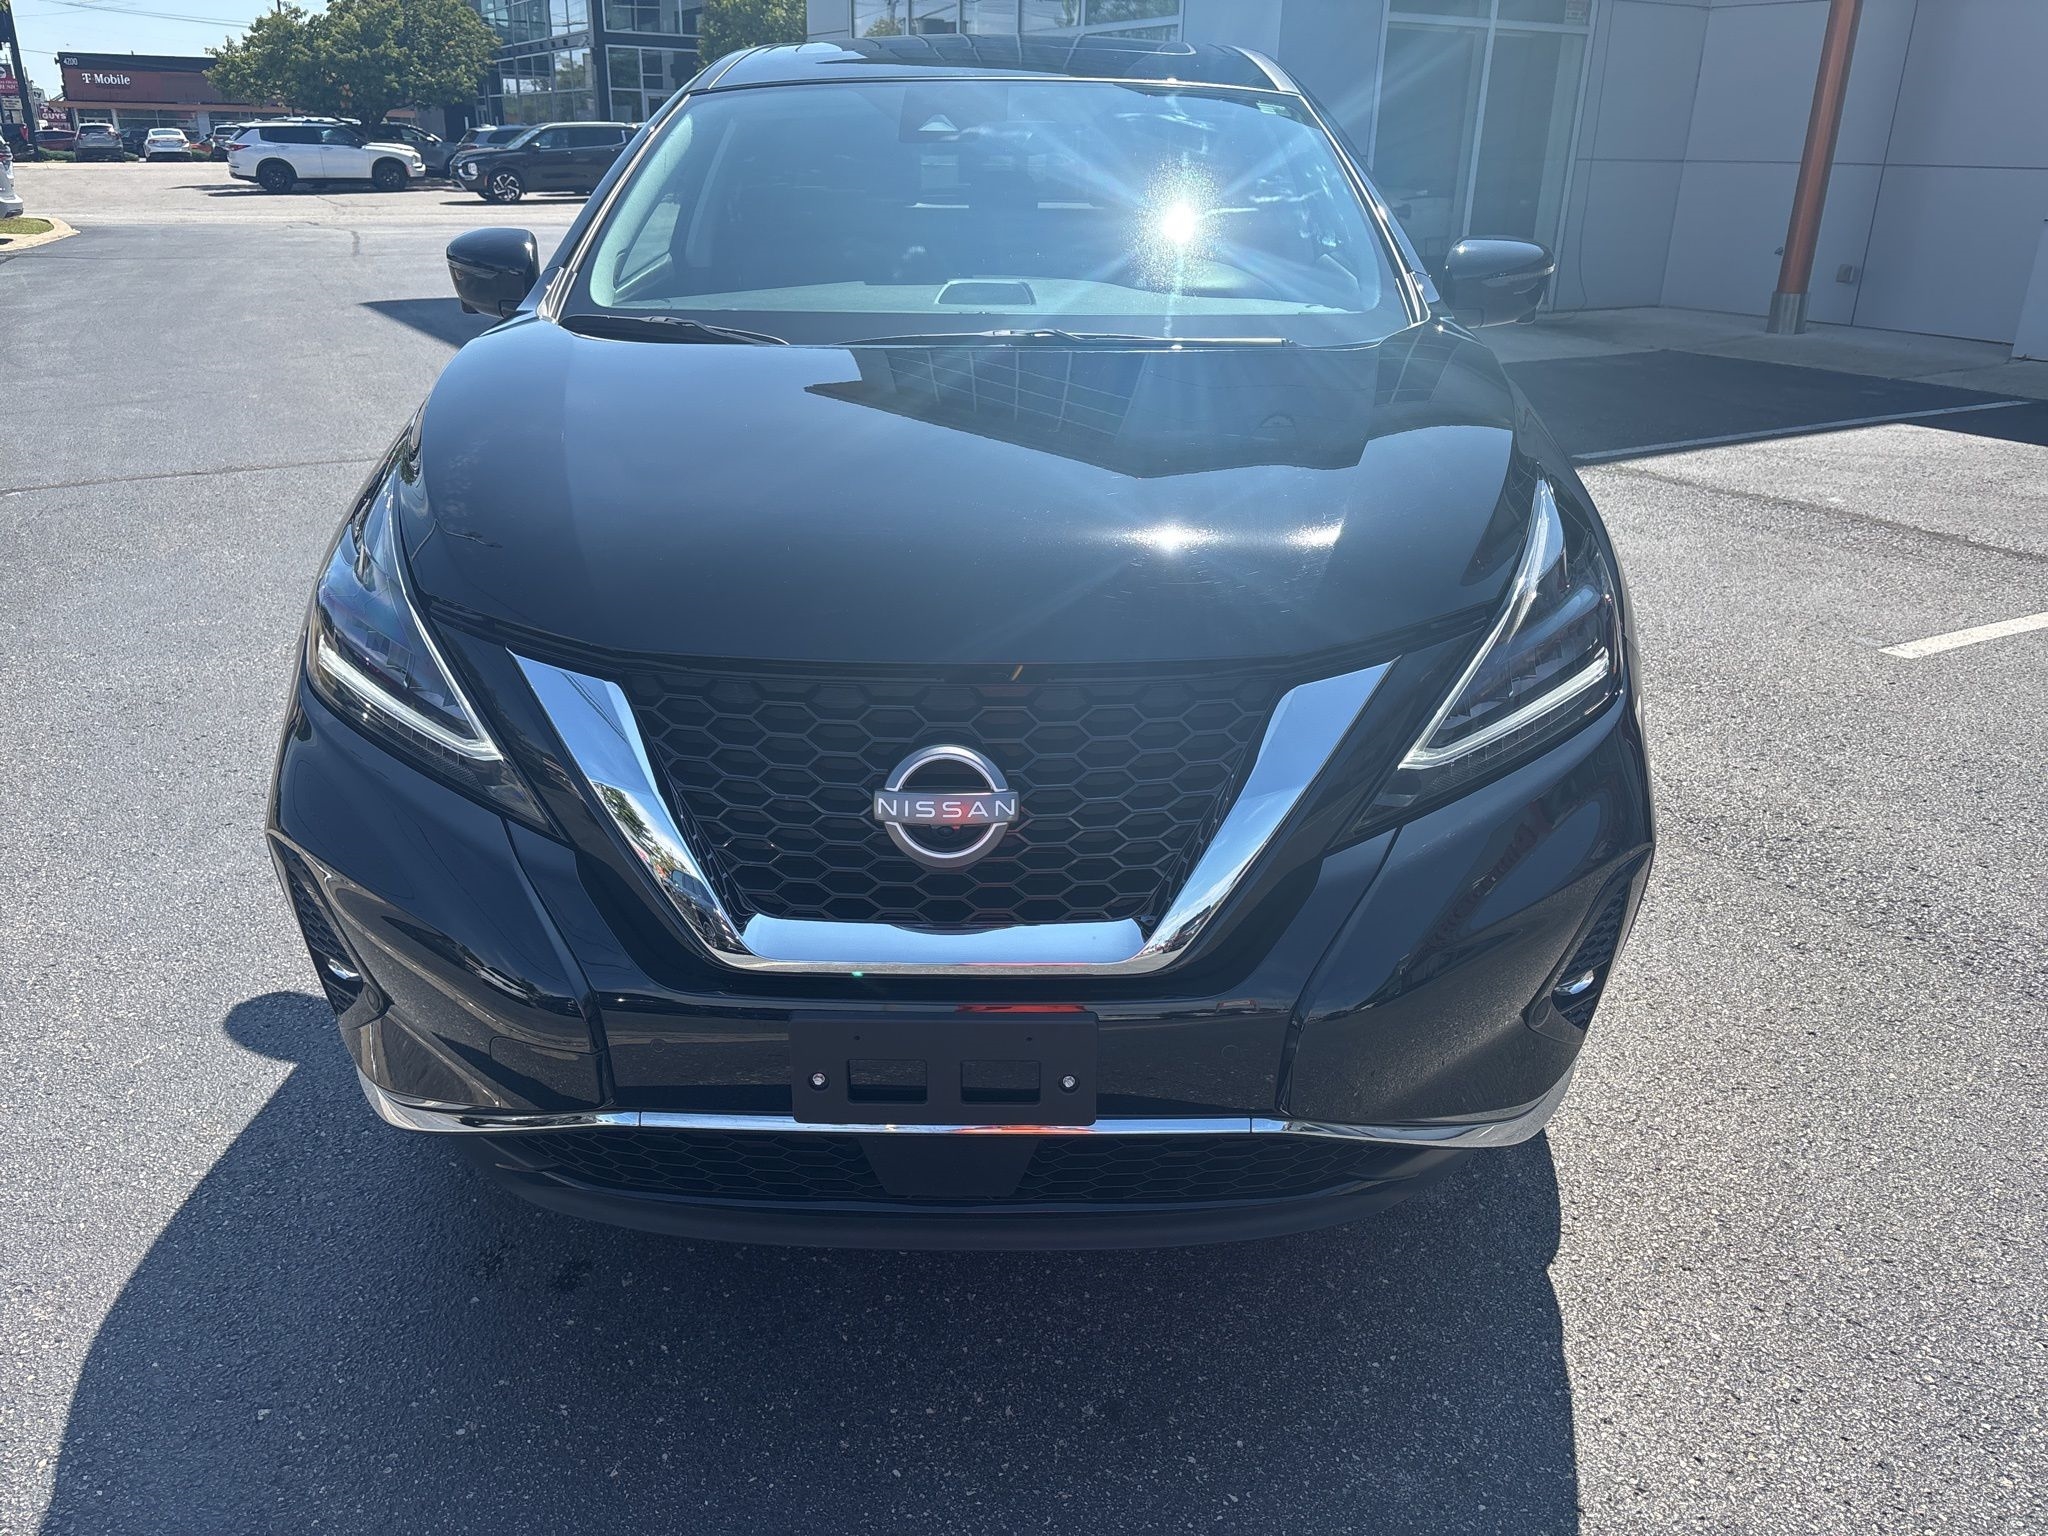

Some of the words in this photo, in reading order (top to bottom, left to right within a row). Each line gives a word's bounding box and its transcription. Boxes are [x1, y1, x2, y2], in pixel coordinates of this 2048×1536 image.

[94, 73, 131, 85] Mobile
[42, 112, 67, 120] GUYS
[877, 797, 1016, 819] NISSAN
